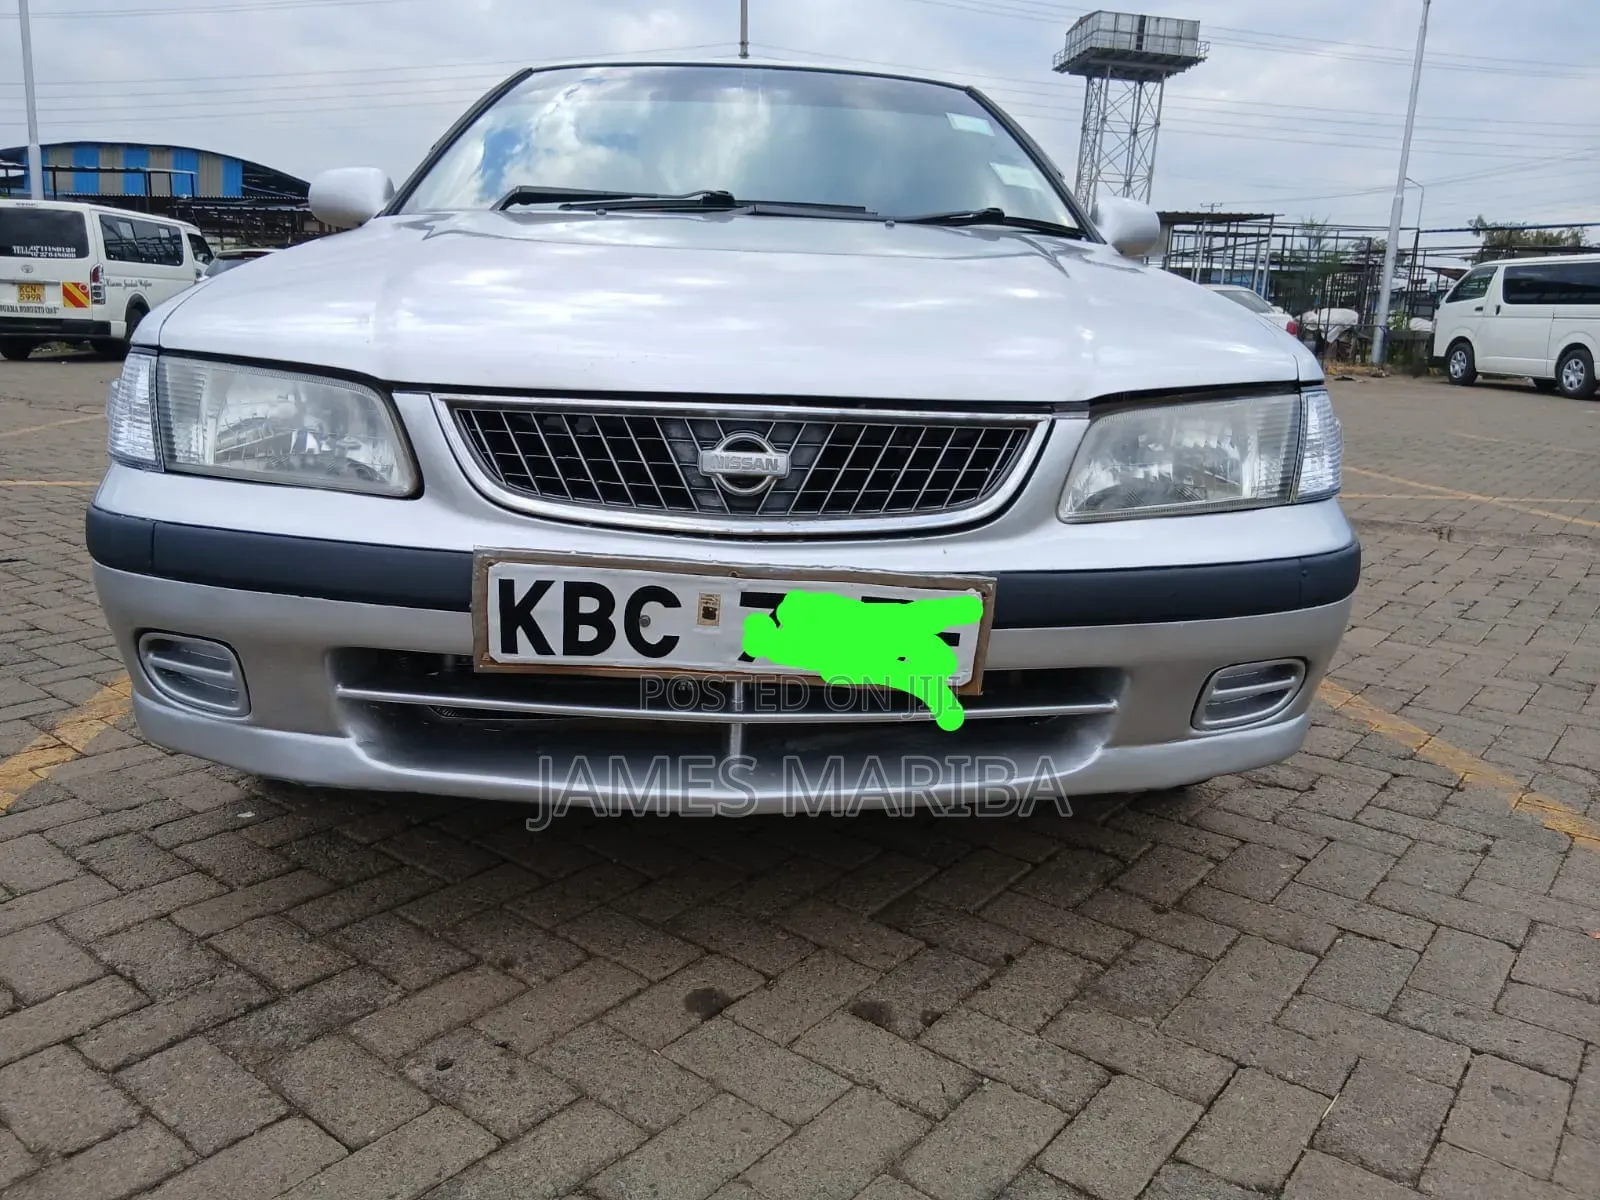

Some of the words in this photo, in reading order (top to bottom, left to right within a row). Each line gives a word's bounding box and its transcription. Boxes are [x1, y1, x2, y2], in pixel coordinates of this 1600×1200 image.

[19, 285, 37, 294] KCN
[710, 454, 779, 472] NISSAN
[498, 578, 682, 659] KBC
